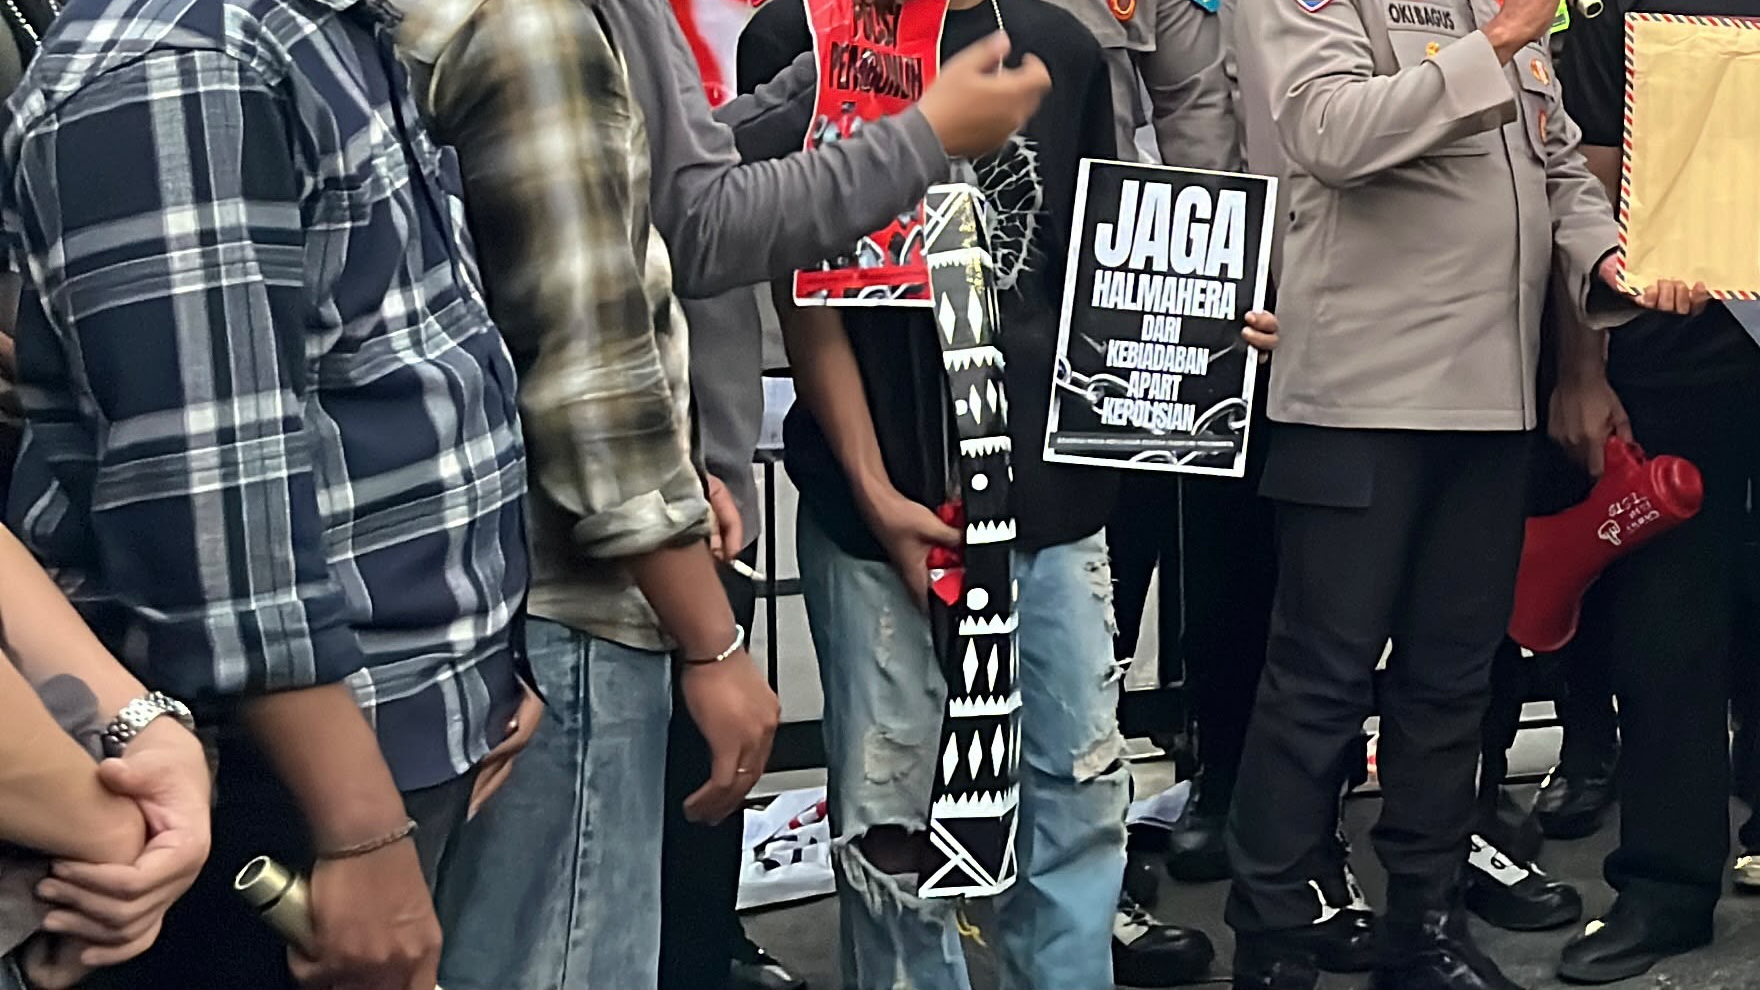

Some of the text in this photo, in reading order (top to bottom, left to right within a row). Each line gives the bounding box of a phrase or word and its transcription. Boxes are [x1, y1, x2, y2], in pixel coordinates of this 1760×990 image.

[1389, 3, 1455, 30] OKI BAGUS
[1094, 179, 1247, 280] JAGA
[1091, 269, 1237, 321] HALMAHERA
[1141, 314, 1182, 344] DARI
[1105, 339, 1210, 376] KEBIADABAN
[1126, 370, 1183, 402] APART
